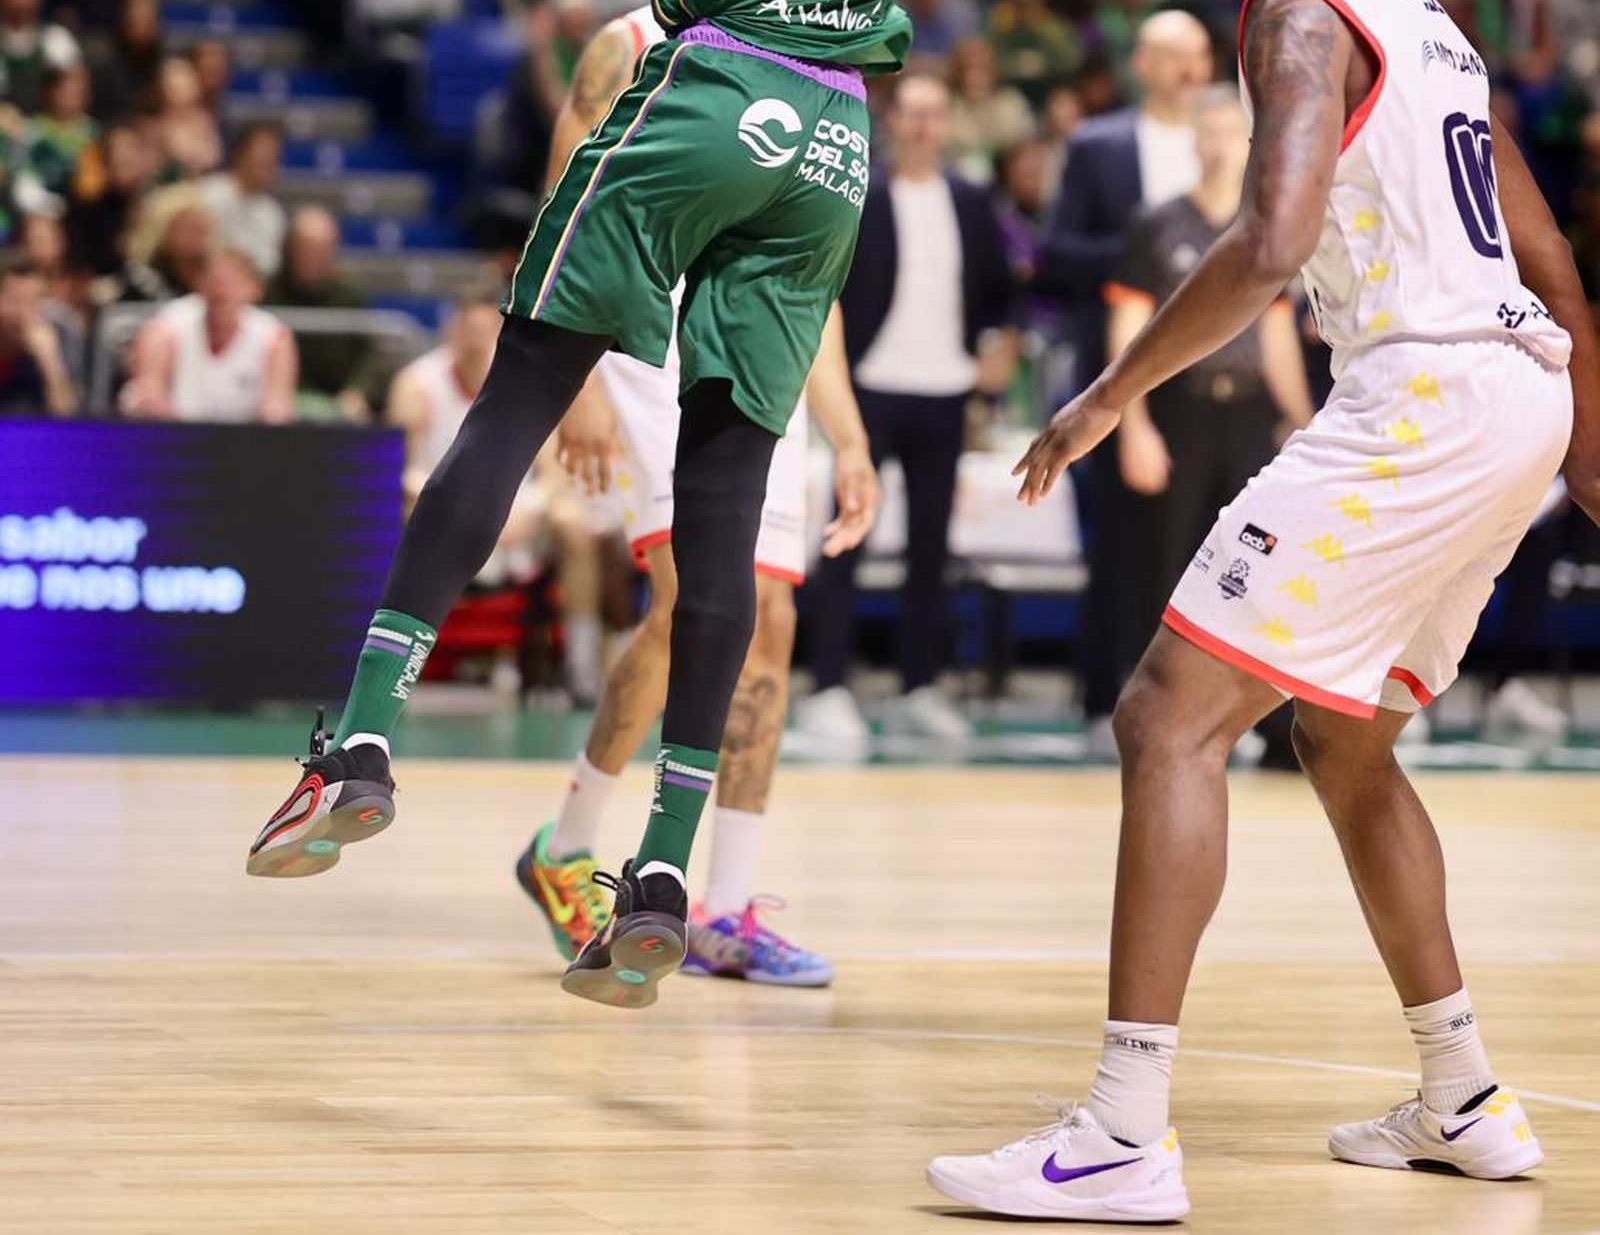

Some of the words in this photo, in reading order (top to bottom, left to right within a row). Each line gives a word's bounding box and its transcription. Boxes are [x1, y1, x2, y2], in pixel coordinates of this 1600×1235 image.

[814, 119, 869, 161] COST
[805, 141, 845, 171] DEL
[848, 159, 869, 184] SO
[391, 642, 428, 700] UNICAJA
